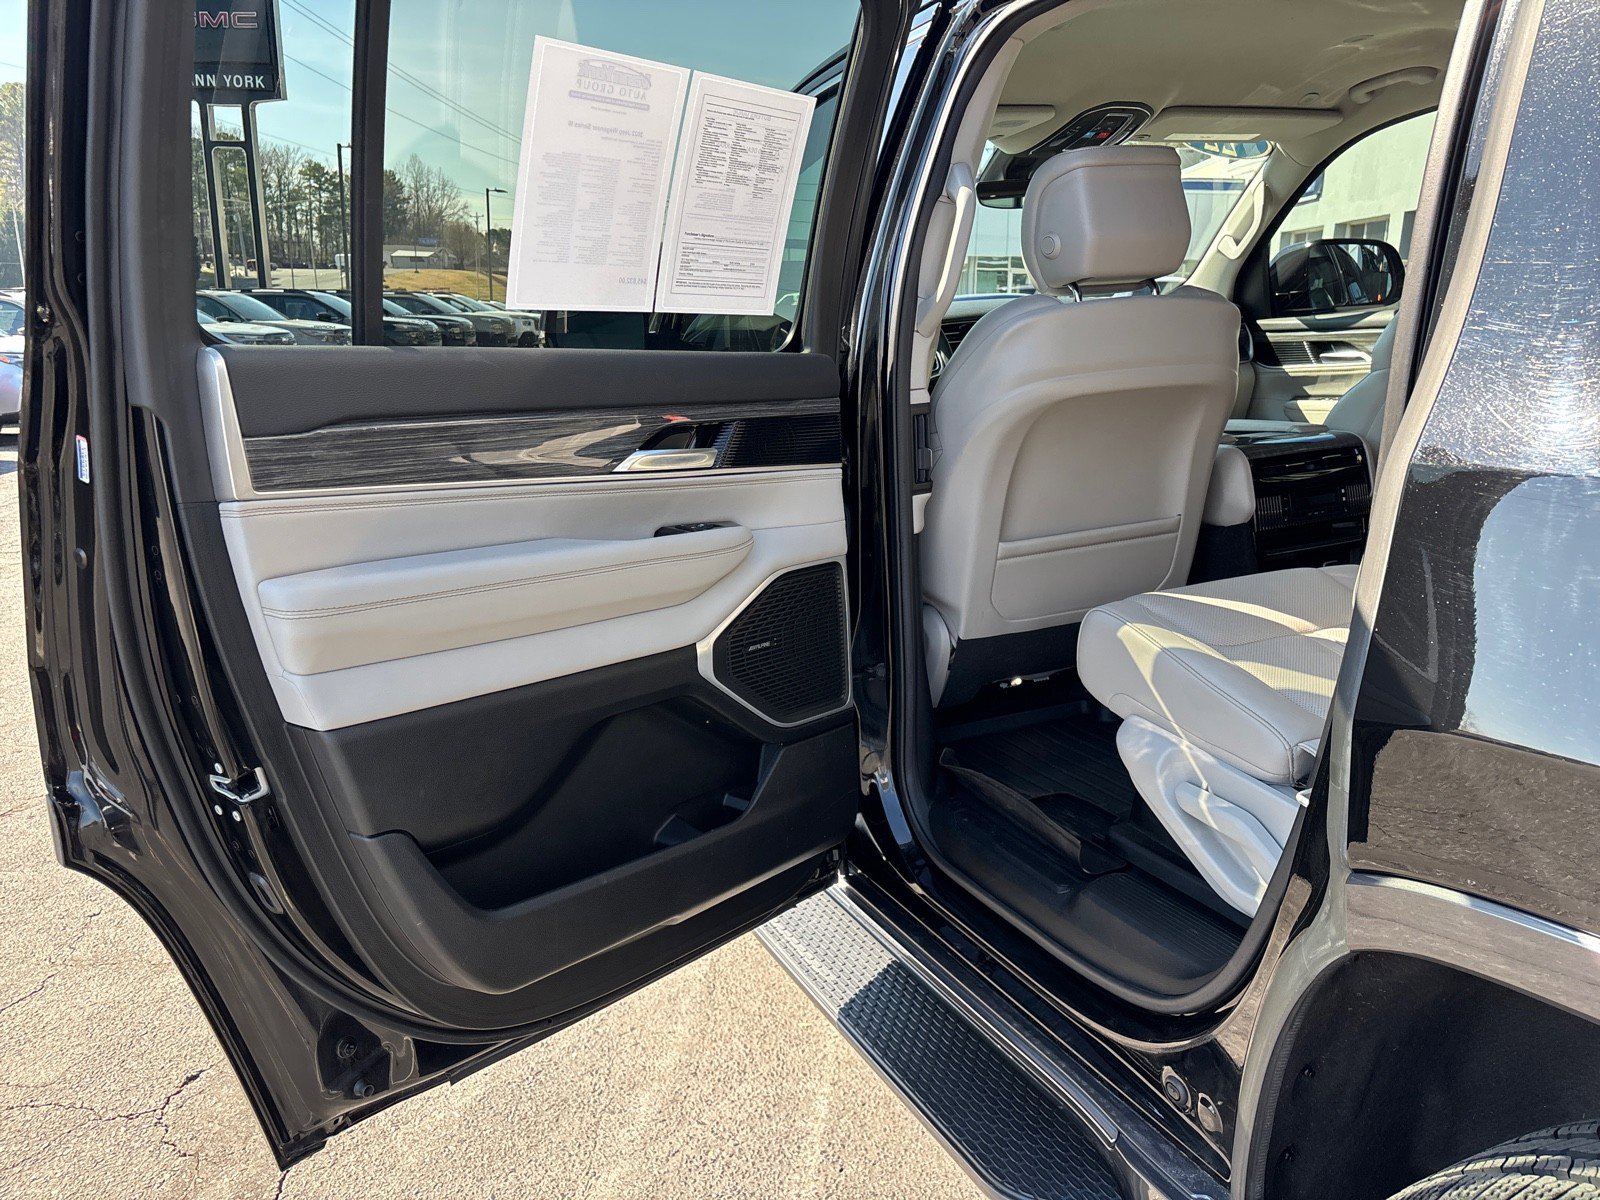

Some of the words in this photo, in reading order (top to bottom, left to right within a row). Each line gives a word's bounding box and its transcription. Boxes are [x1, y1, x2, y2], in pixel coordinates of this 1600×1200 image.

[194, 11, 258, 28] MC
[192, 74, 216, 87] NN
[223, 74, 265, 89] YORK
